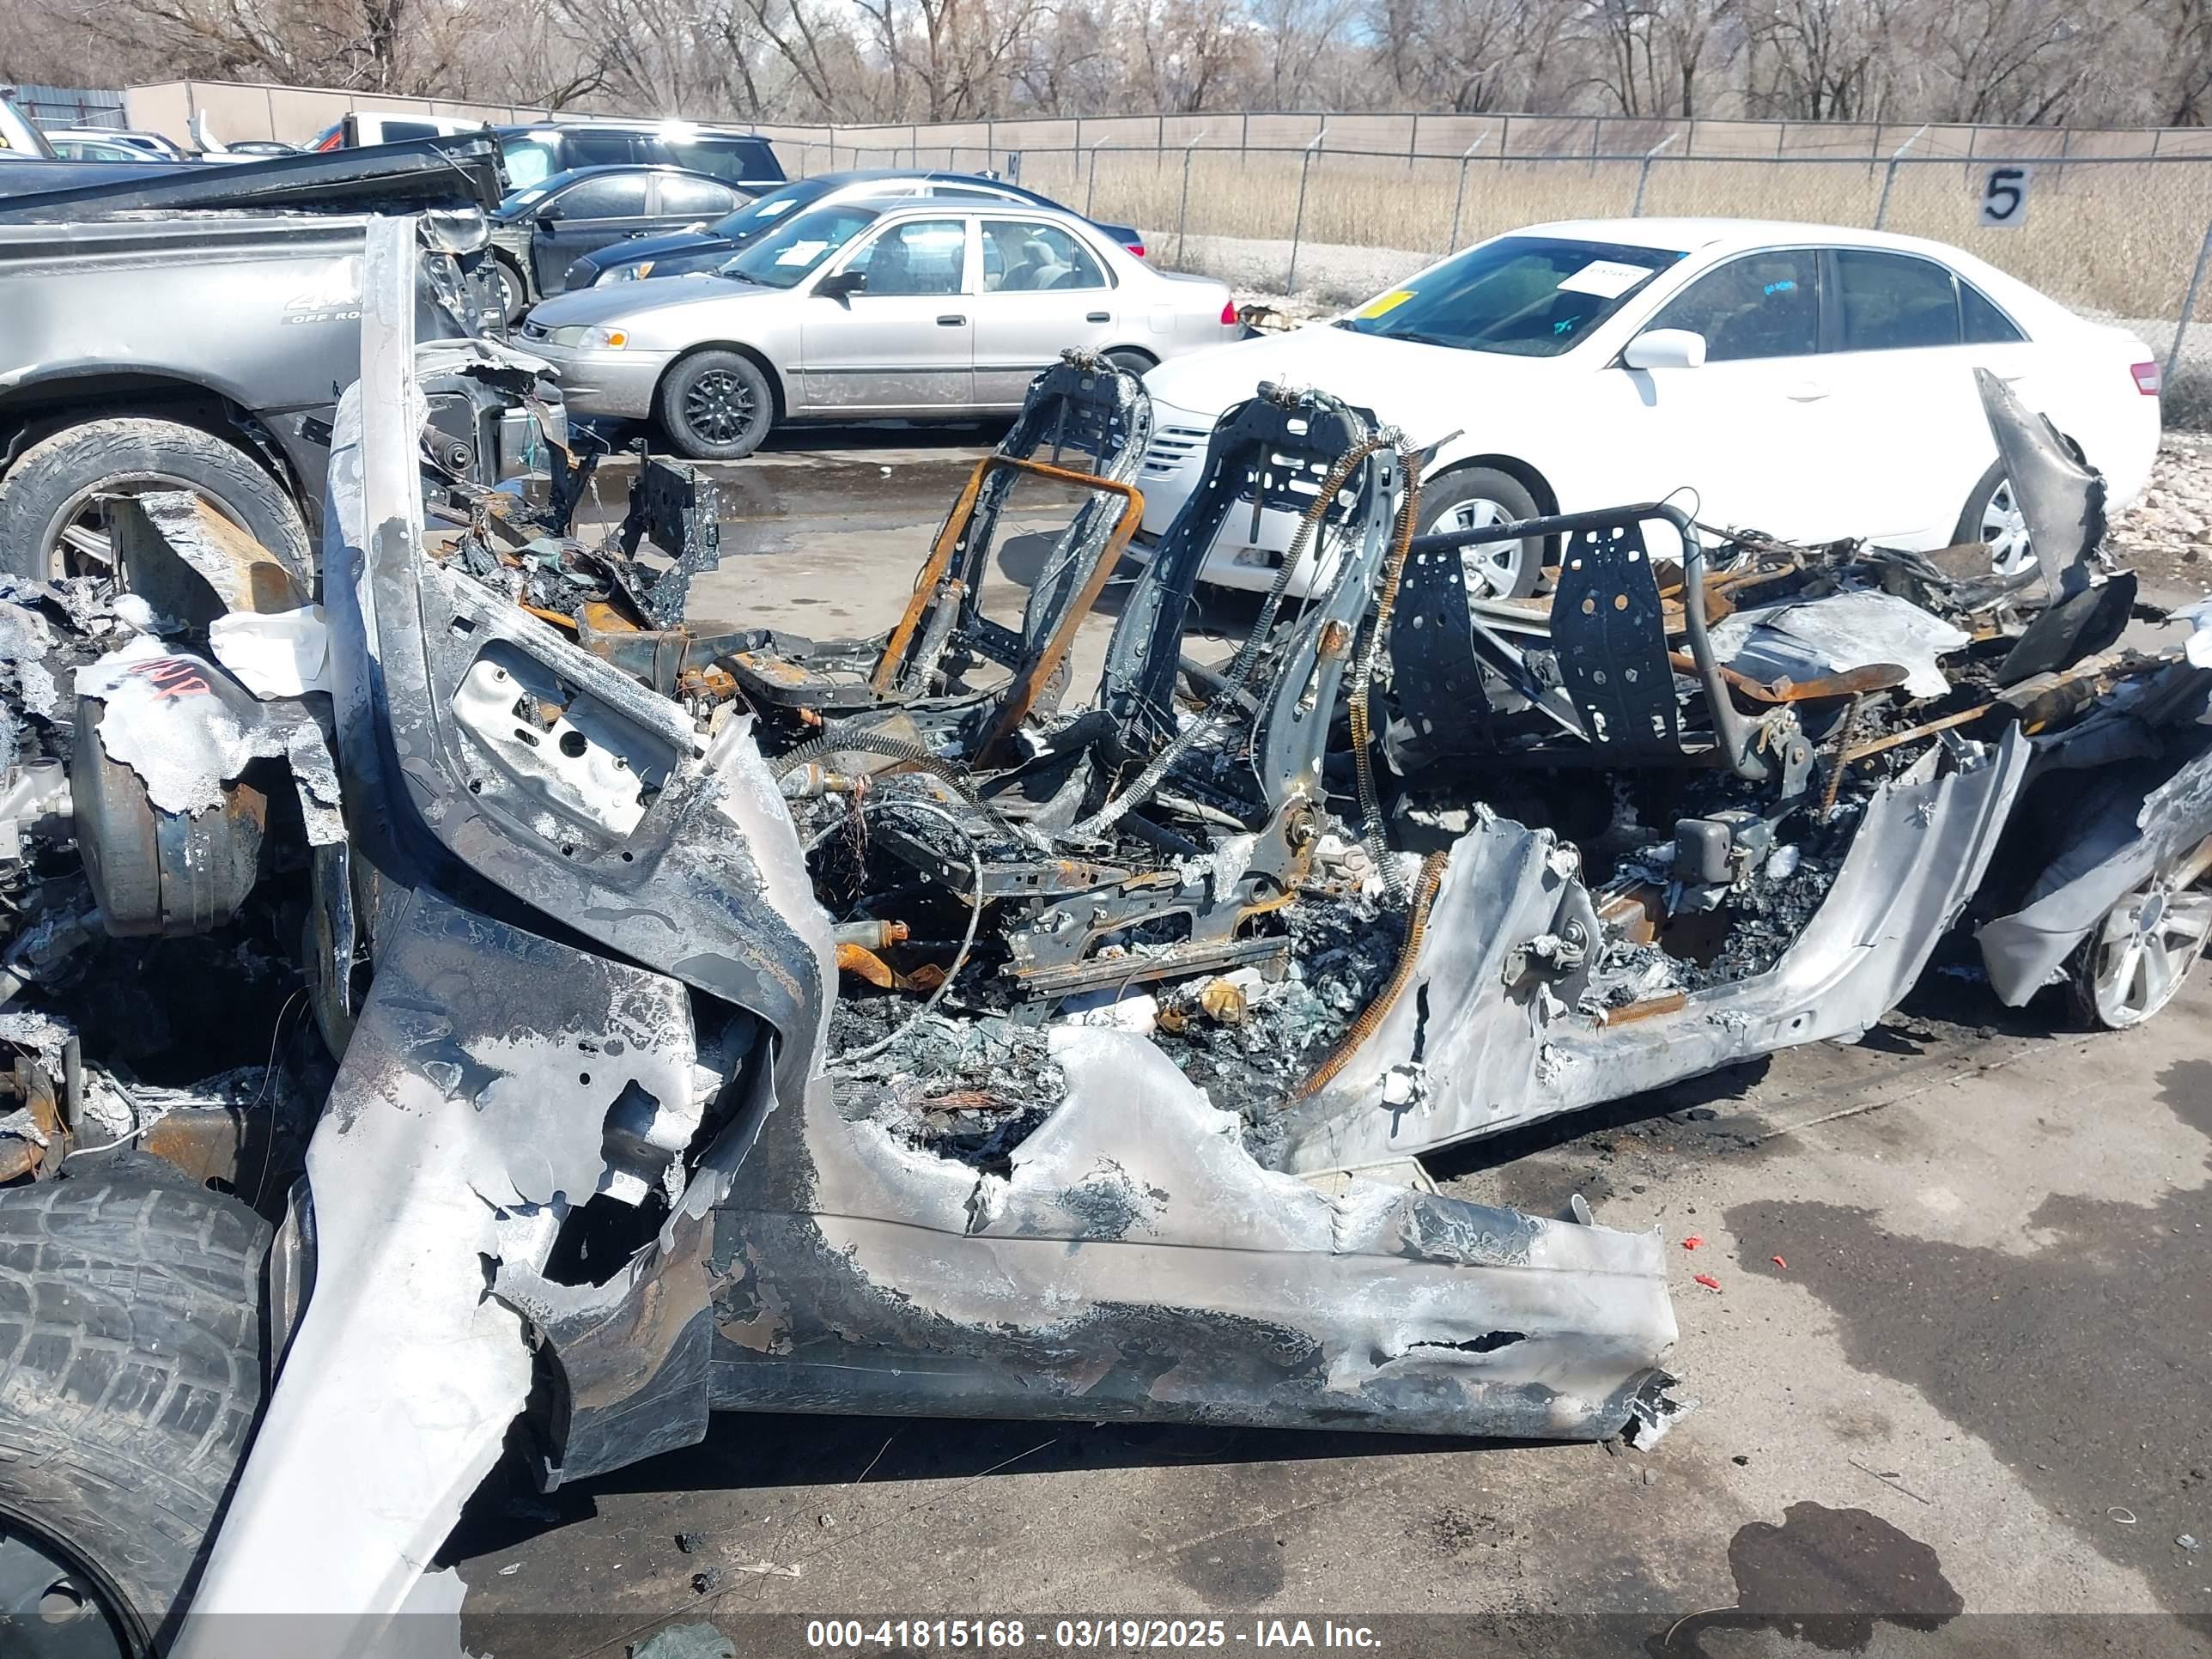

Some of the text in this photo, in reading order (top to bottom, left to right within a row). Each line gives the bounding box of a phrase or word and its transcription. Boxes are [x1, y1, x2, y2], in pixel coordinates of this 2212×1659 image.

[1984, 170, 2024, 220] 5
[292, 311, 363, 324] OFF RO
